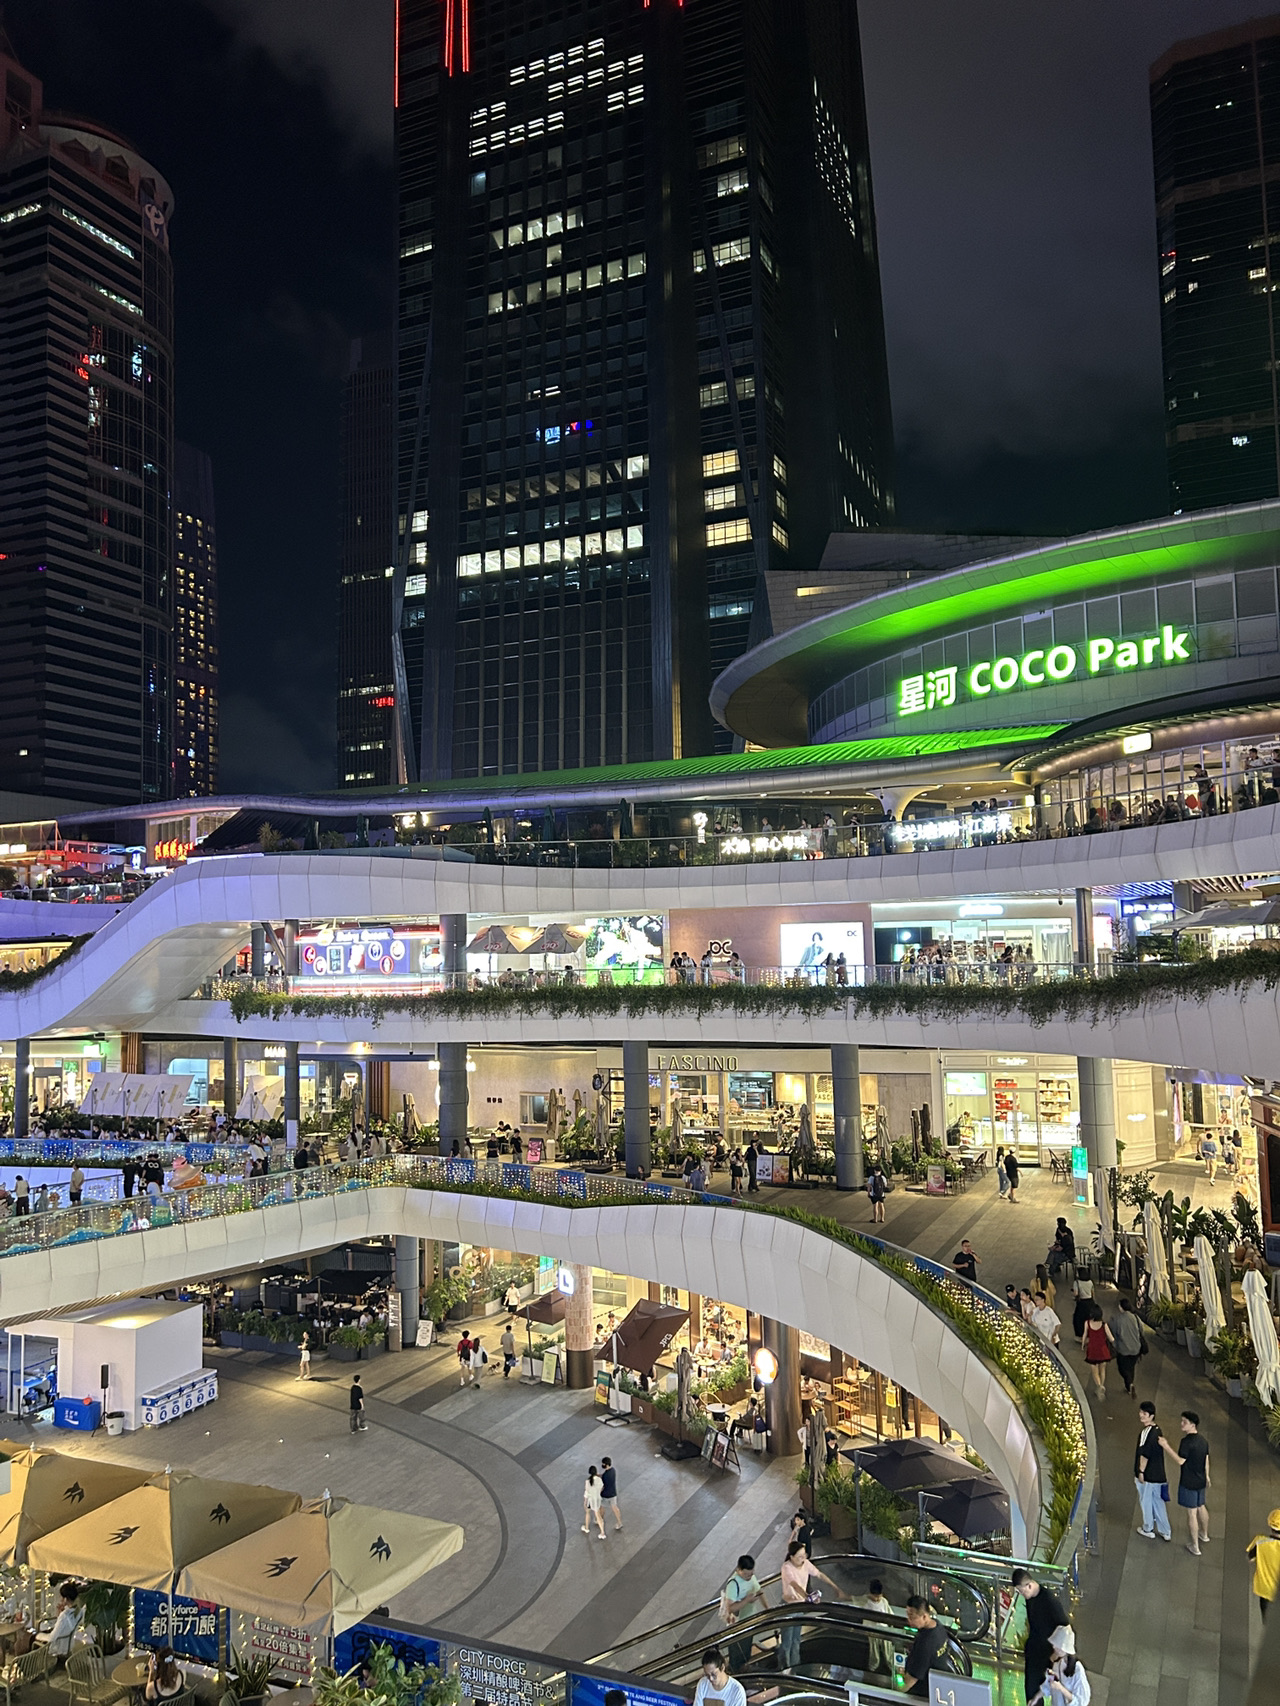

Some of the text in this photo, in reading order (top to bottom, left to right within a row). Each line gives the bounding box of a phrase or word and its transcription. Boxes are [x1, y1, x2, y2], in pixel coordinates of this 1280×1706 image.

[899, 625, 1191, 717] 星河 COCO Park
[657, 1055, 739, 1072] FASCINO
[151, 1613, 216, 1637] 都市力酿
[460, 1649, 527, 1675] CITY FORCE
[460, 1664, 556, 1699] 深圳精酿啤酒节&
[645, 1696, 658, 1704] BEER
